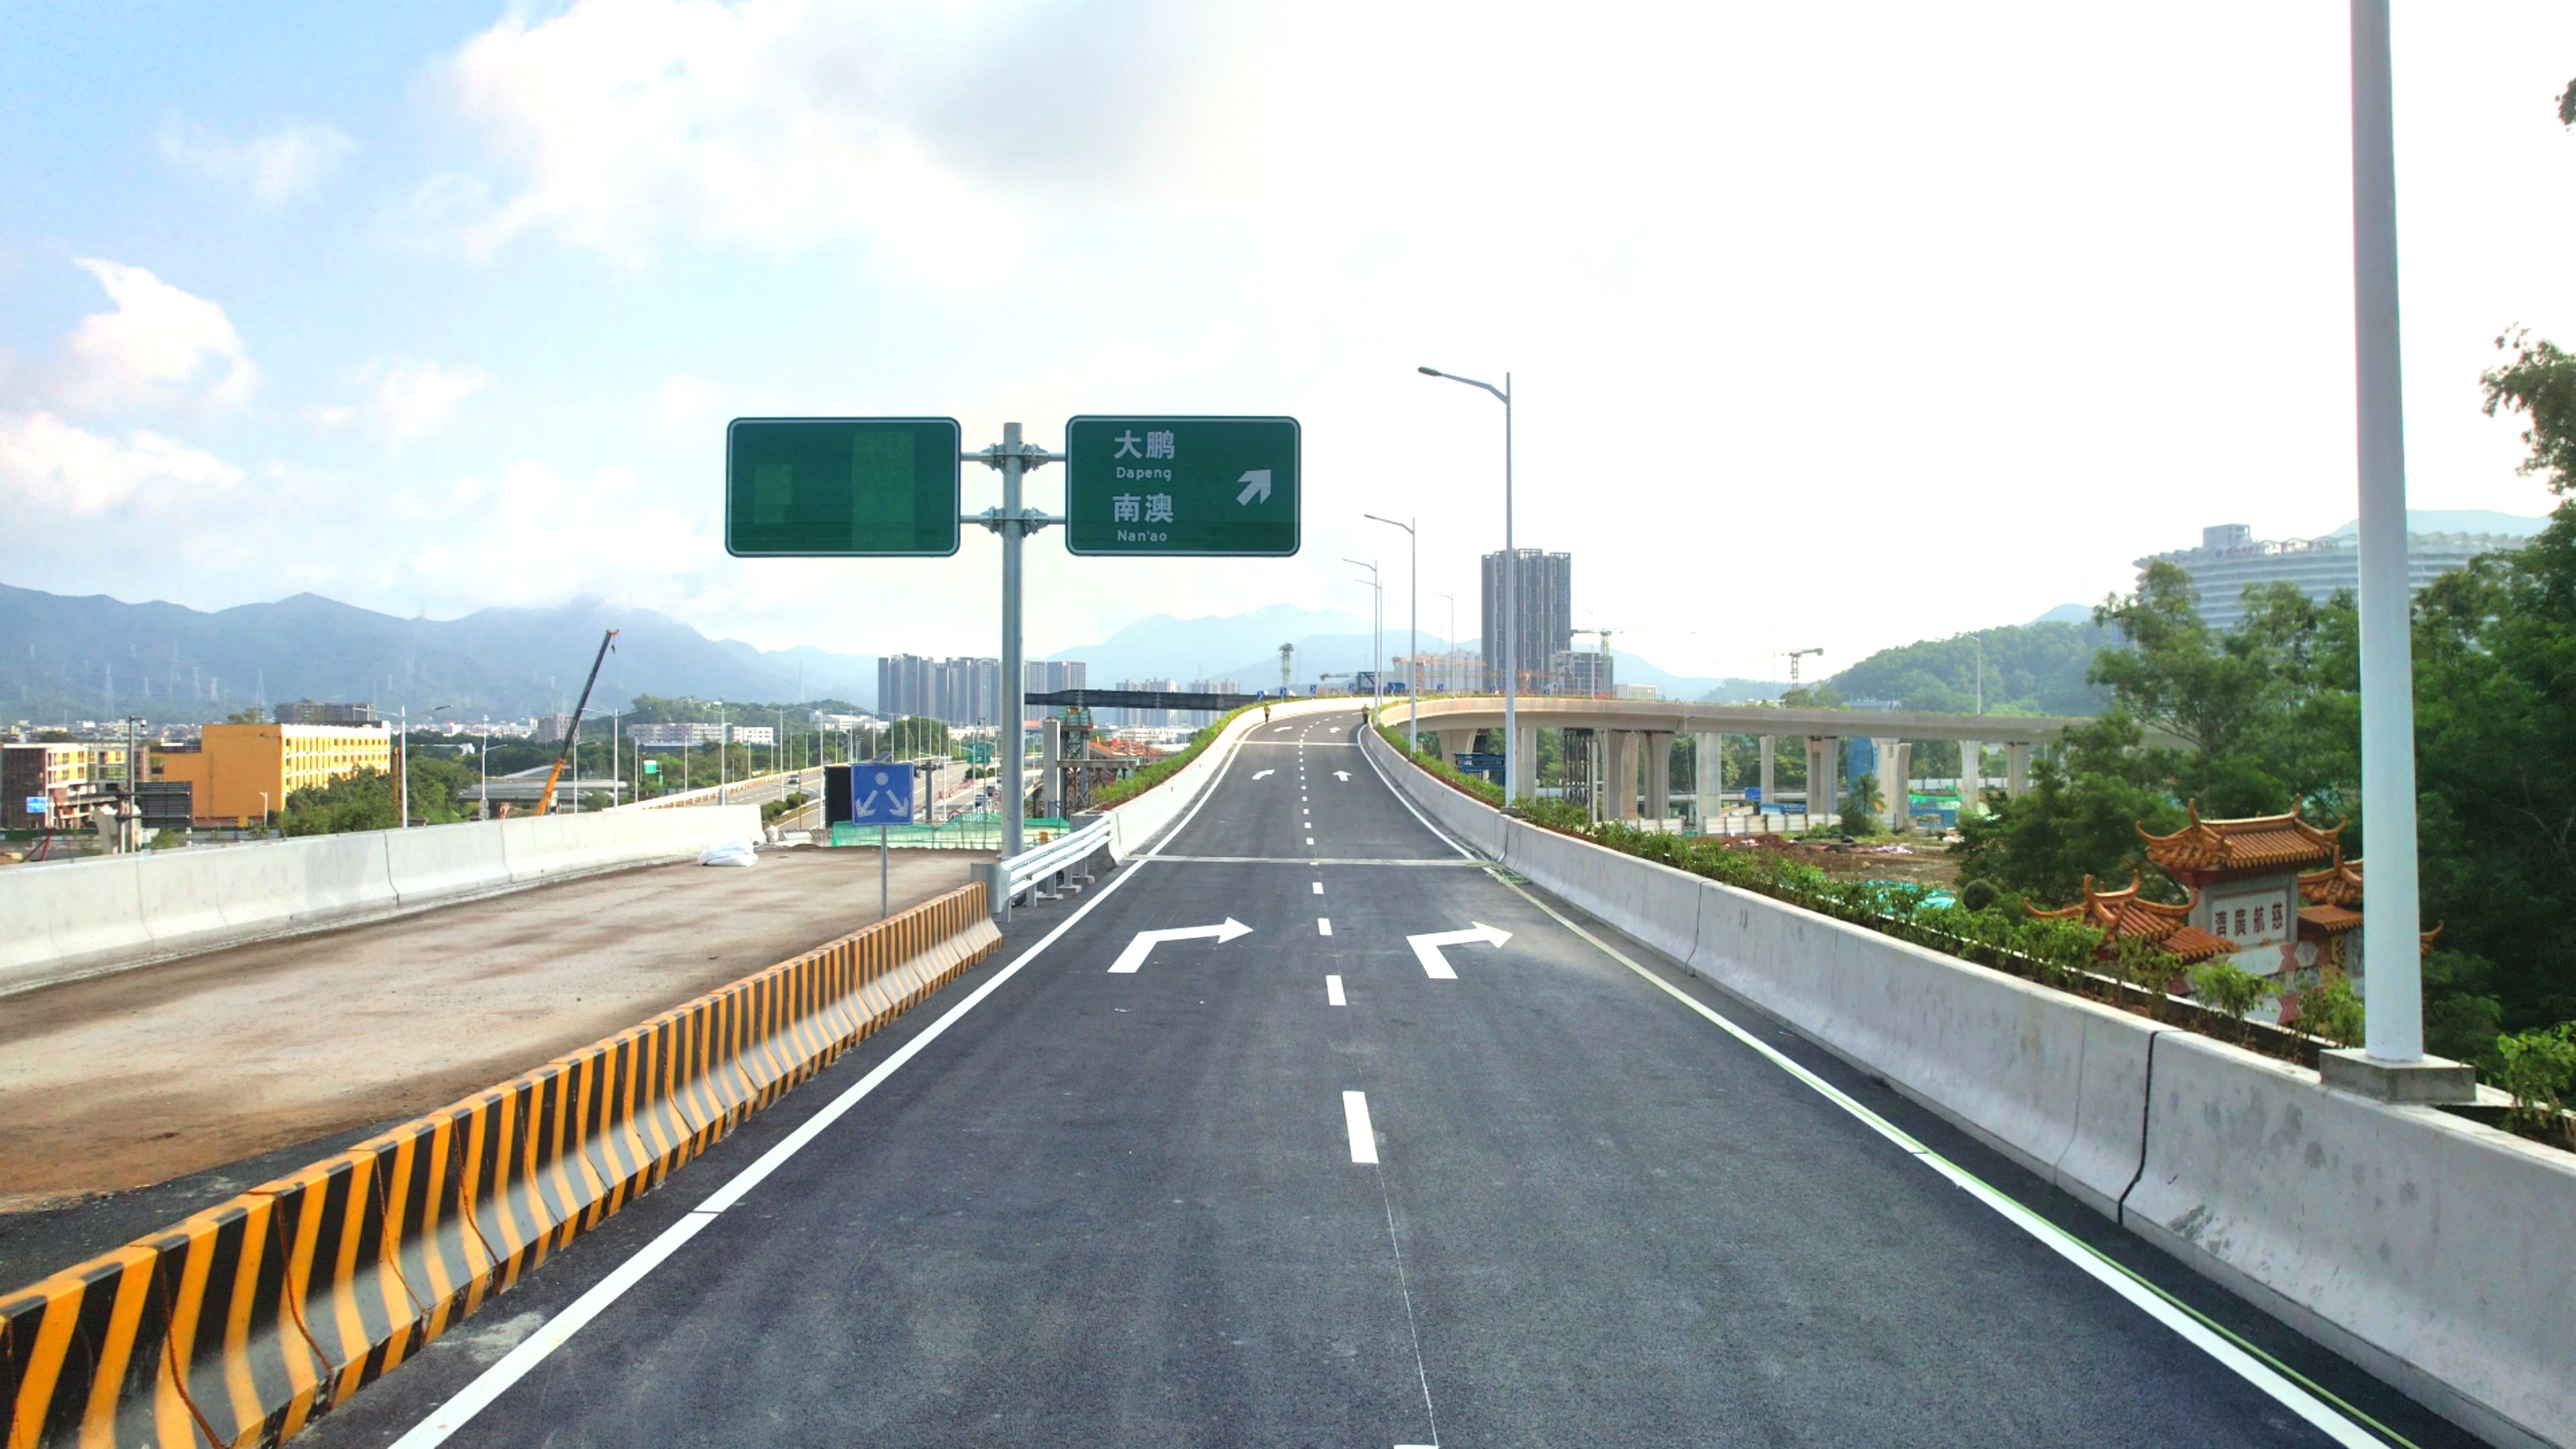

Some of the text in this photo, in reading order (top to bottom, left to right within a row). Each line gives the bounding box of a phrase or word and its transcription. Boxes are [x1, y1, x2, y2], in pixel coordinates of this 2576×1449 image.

[1113, 429, 1175, 460] 大鹏
[1116, 466, 1172, 482] Dapeng
[1112, 493, 1173, 523] 南澳
[1117, 529, 1167, 541] Nan'ao
